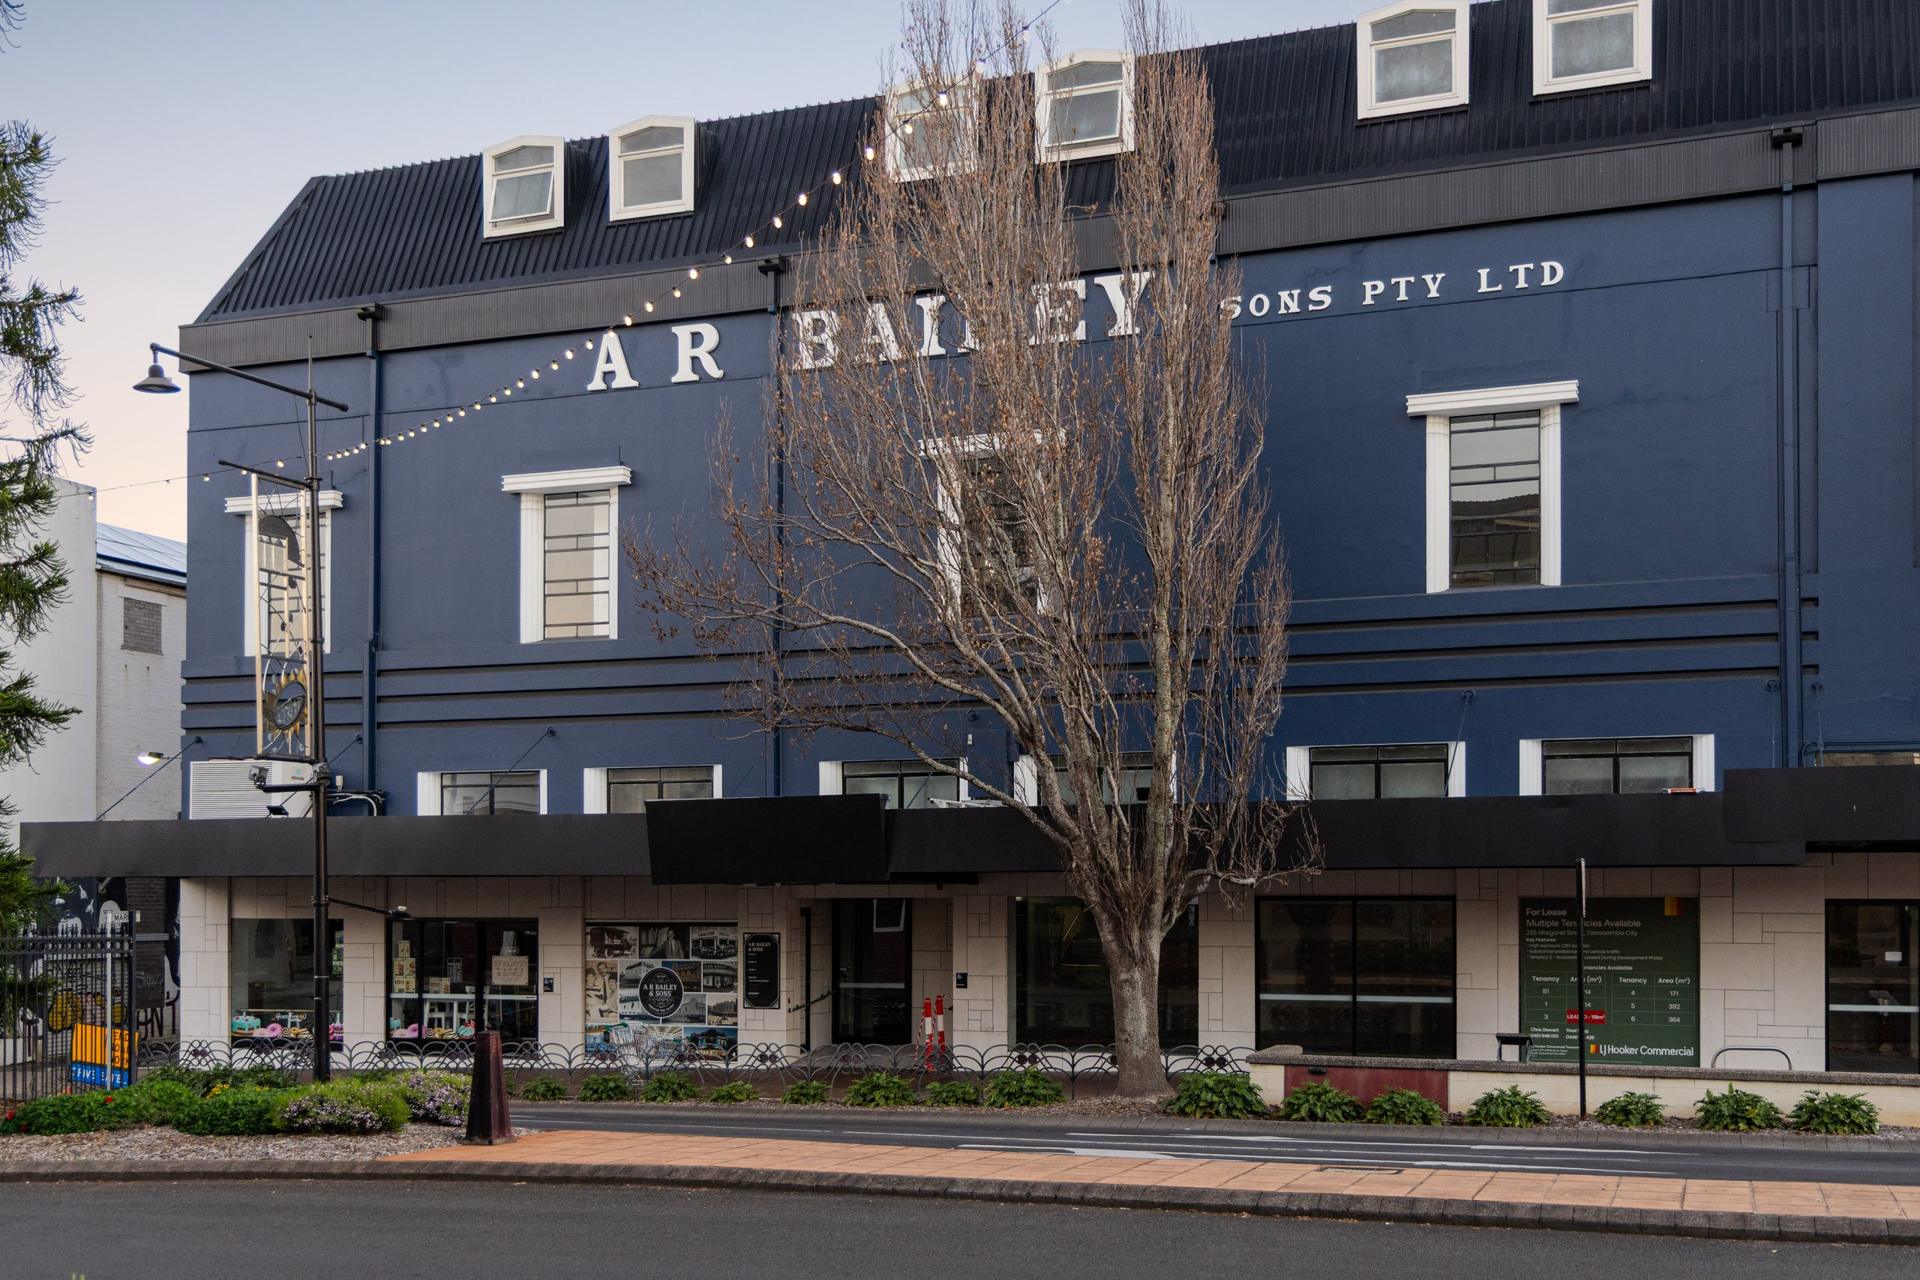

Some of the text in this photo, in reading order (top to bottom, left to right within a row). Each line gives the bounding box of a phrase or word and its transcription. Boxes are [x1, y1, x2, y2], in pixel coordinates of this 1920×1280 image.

[586, 335, 639, 391] A
[671, 323, 724, 383] R
[791, 271, 1155, 370] BAIEY
[1219, 285, 1332, 320] SONS
[1362, 273, 1445, 305] PTY
[1477, 261, 1564, 293] LTD
[1526, 908, 1567, 916] For Lease
[1526, 919, 1641, 928] Multiple Tenncies Available
[1600, 1045, 1694, 1056] LJ Hooker Commercial
